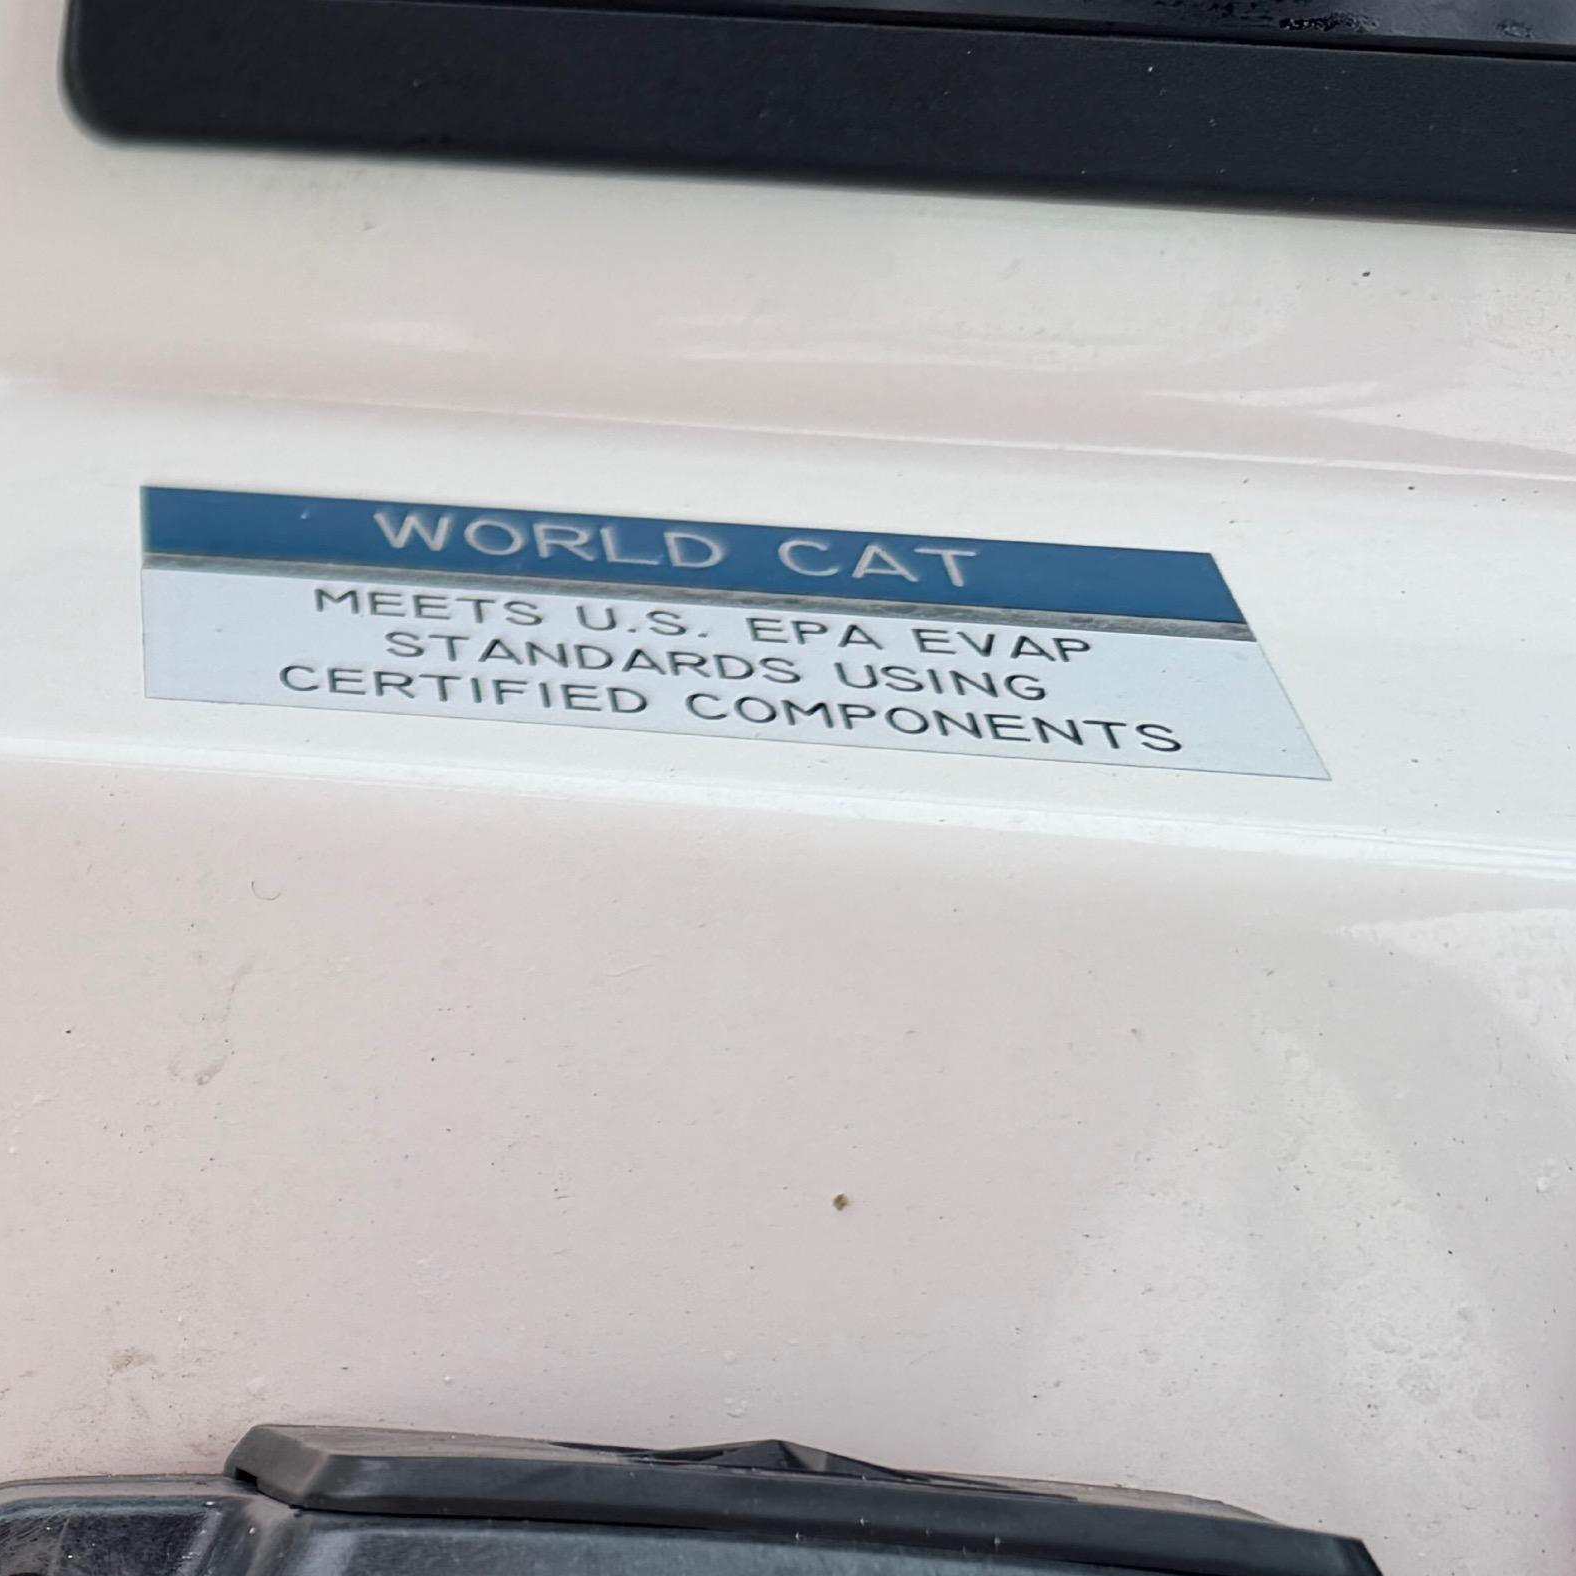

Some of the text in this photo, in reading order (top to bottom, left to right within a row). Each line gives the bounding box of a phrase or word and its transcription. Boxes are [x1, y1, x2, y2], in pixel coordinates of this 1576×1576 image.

[373, 511, 977, 588] WORLD CAT
[314, 588, 1091, 663] MEETS U.S. EPA EVAP
[385, 631, 1047, 701] STANDARDS USING
[279, 665, 1183, 753] CERTIFIED COMPONENTS
